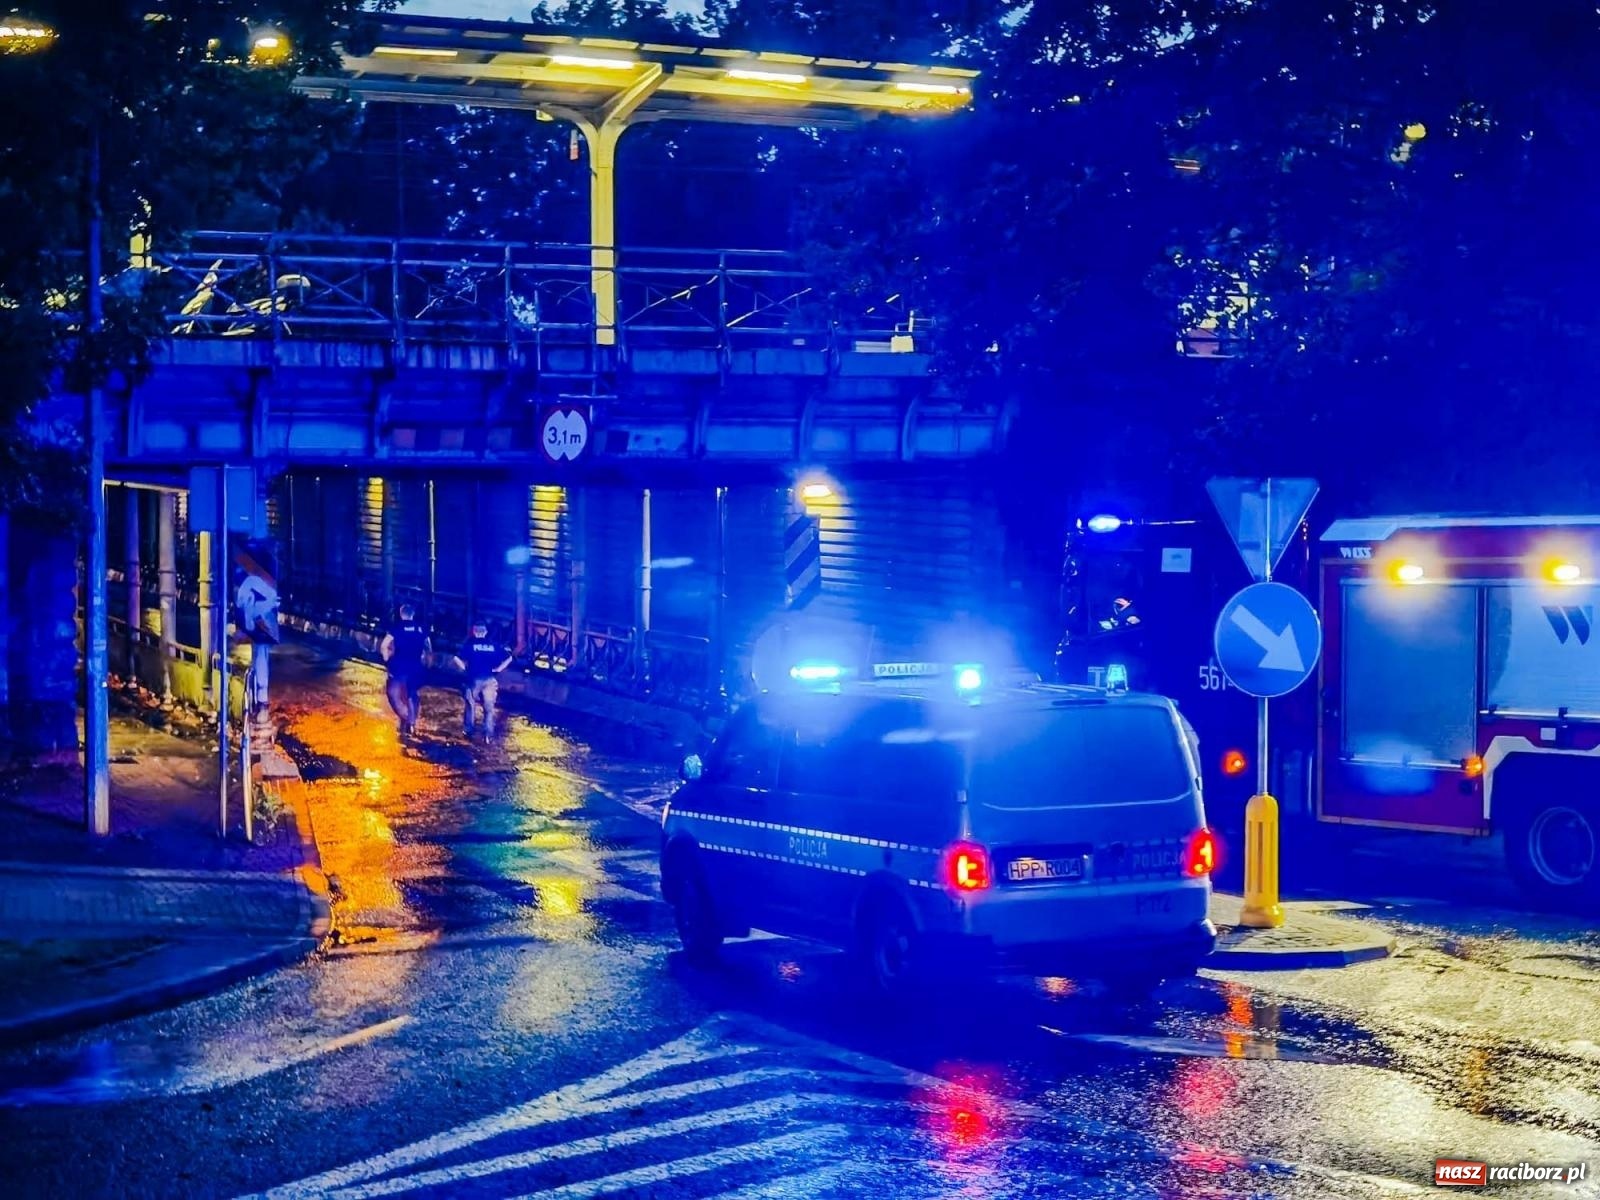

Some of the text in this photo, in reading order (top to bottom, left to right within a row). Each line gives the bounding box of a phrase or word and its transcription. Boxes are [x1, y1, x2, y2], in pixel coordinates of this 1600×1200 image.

[878, 664, 934, 675] POLICJA
[789, 836, 828, 858] POLICJA
[1132, 850, 1186, 870] POLICJA
[1010, 862, 1041, 878] HPP
